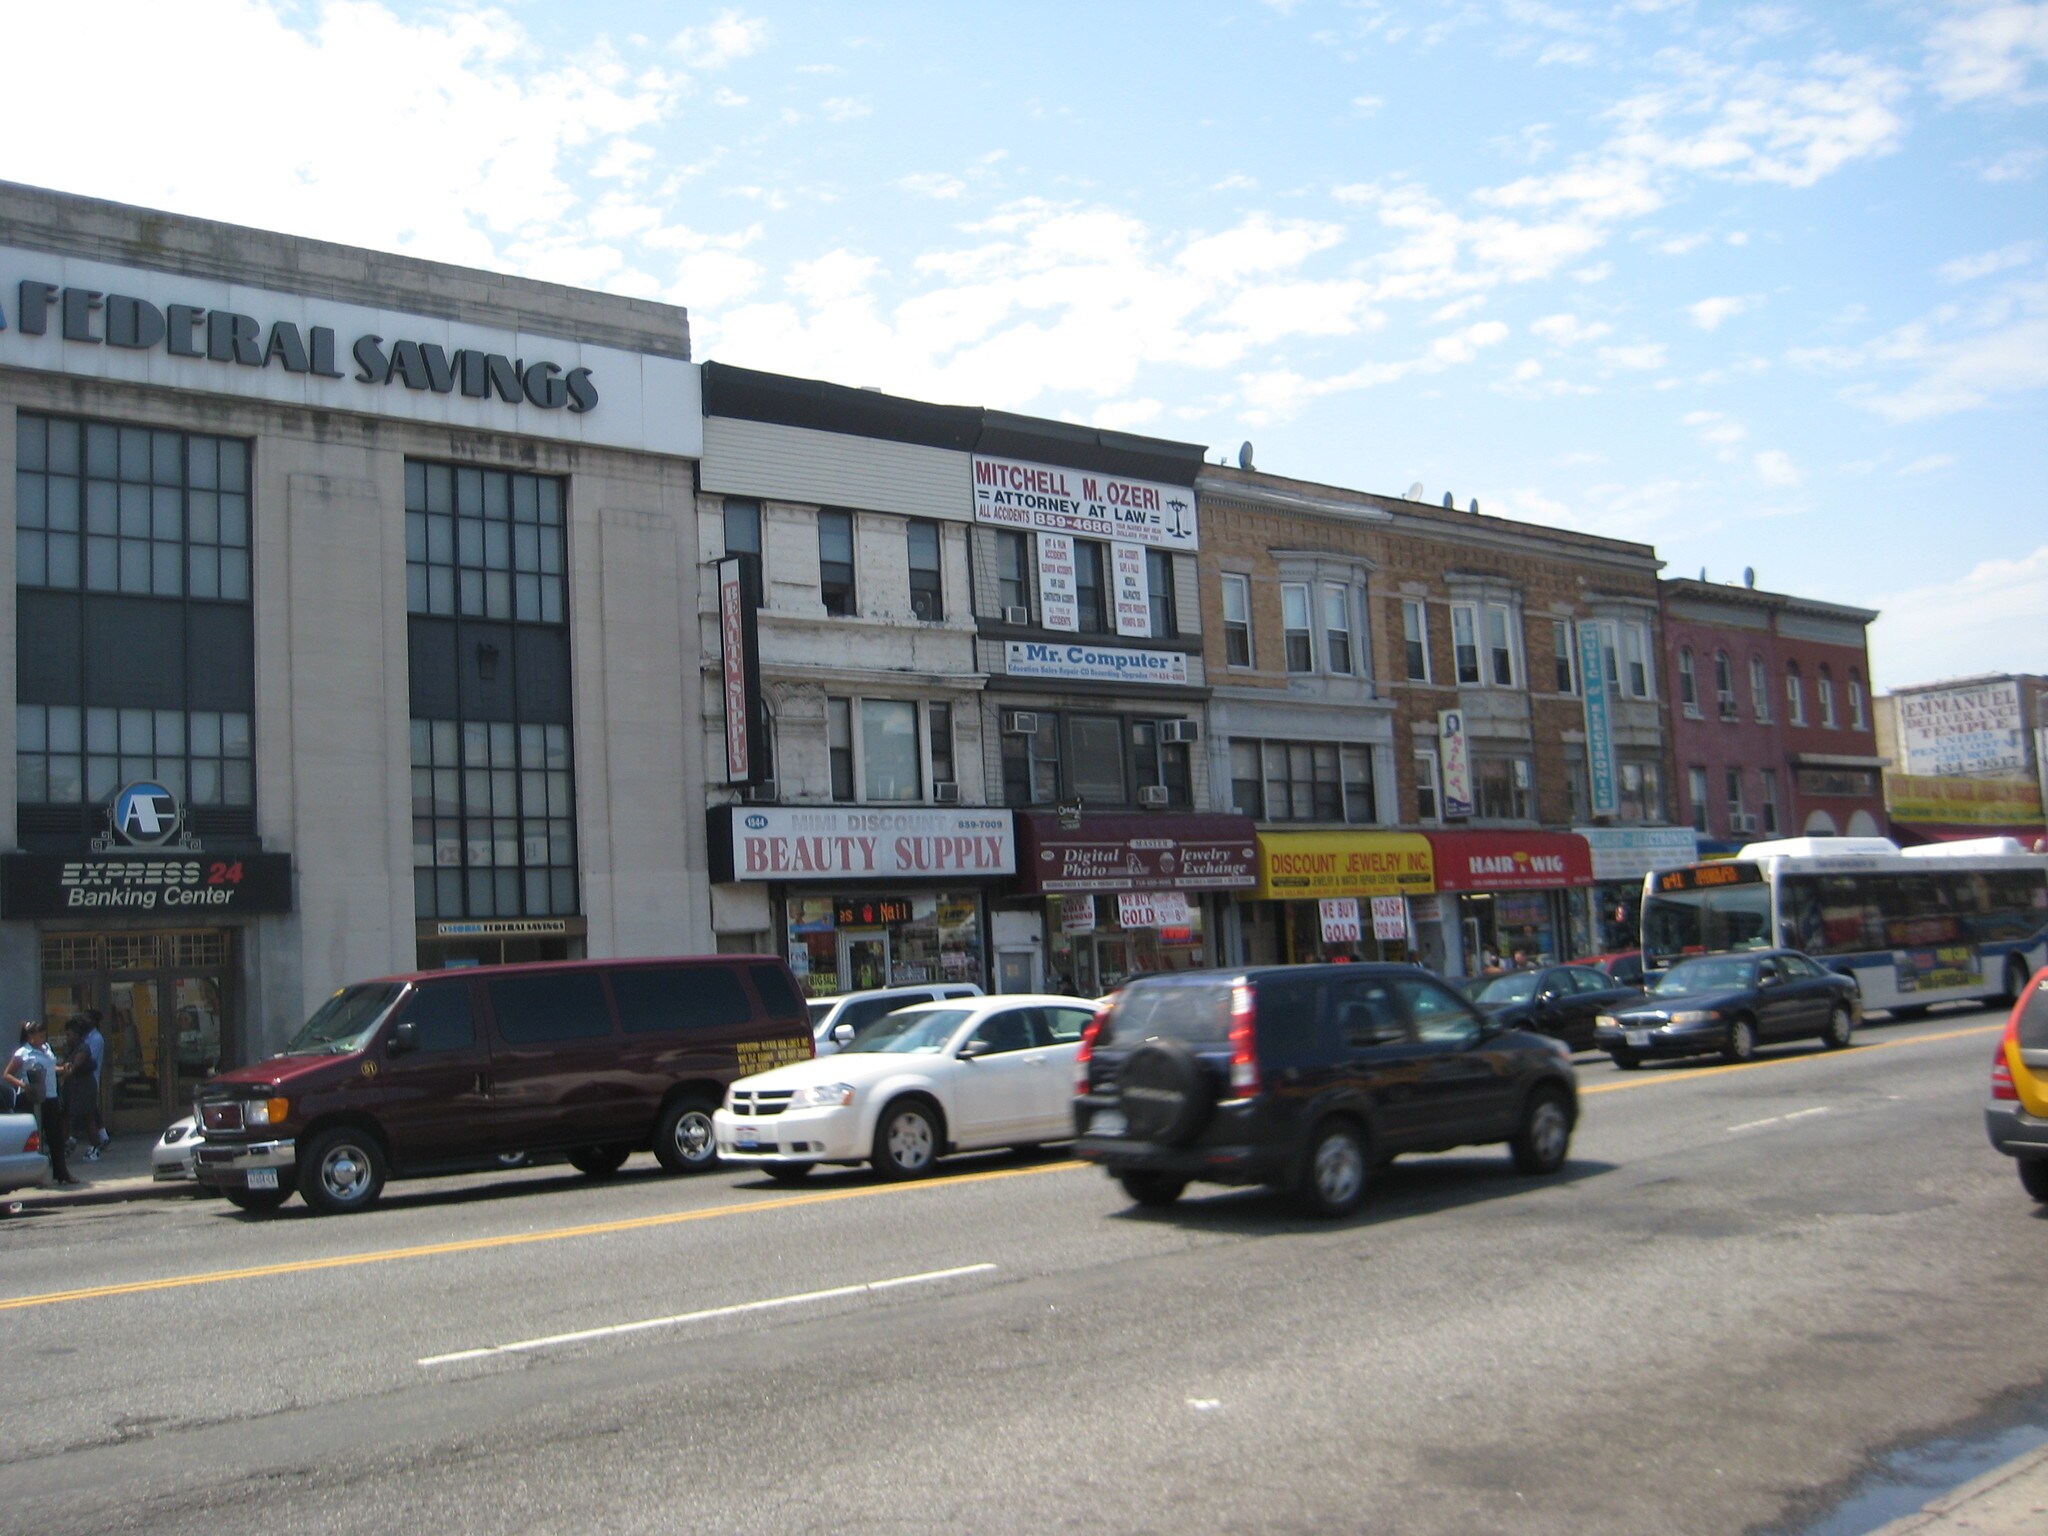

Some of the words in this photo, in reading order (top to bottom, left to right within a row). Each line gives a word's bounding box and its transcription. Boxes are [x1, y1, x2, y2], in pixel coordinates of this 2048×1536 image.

[19, 279, 345, 378] FEDERAL
[353, 334, 599, 414] SAVINGS
[976, 460, 1070, 497] MITCHELL
[1082, 478, 1102, 502] M.
[1107, 482, 1160, 511] OZERI
[994, 489, 1080, 514] ATTORNEY
[1088, 504, 1106, 519] AT
[1114, 507, 1146, 524] LAW
[979, 504, 991, 517] ALL
[994, 506, 1029, 523] ACCIDENTS
[1035, 513, 1112, 534] 859-4686
[726, 584, 740, 673] BEAUTY
[1026, 644, 1062, 663] Mr.
[1067, 647, 1168, 670] Computer
[1905, 689, 2016, 717] EMMANUEL
[729, 681, 745, 769] SUPPLY
[1905, 705, 2018, 729] DELIVERANCE
[1921, 719, 2008, 738] TEMPLE
[791, 814, 837, 831] MIMI
[848, 814, 948, 832] DISCOUNT
[743, 836, 878, 873] BEAUTY
[894, 835, 1005, 870] SUPPLY
[1064, 849, 1119, 866] Digital
[1180, 848, 1231, 863] Jewelry
[1271, 853, 1336, 874] DISCOUNT
[1346, 852, 1401, 872] JEWELRY
[1469, 856, 1514, 874] HAIR
[1530, 855, 1563, 873] WIG
[61, 862, 201, 885] EXPRESS
[208, 862, 243, 884] 24
[1063, 863, 1107, 877] Photo
[1183, 861, 1247, 875] Exchange
[68, 887, 157, 909] Banking
[164, 886, 234, 906] Center
[1121, 896, 1133, 906] WE
[1135, 893, 1152, 905] BUY
[880, 902, 907, 923] Nail
[1121, 908, 1155, 925] GOLD
[1337, 901, 1354, 918] BUY
[484, 922, 525, 932] FEDERAL
[527, 921, 564, 931] SAVINGS
[1325, 923, 1357, 941] GOLD
